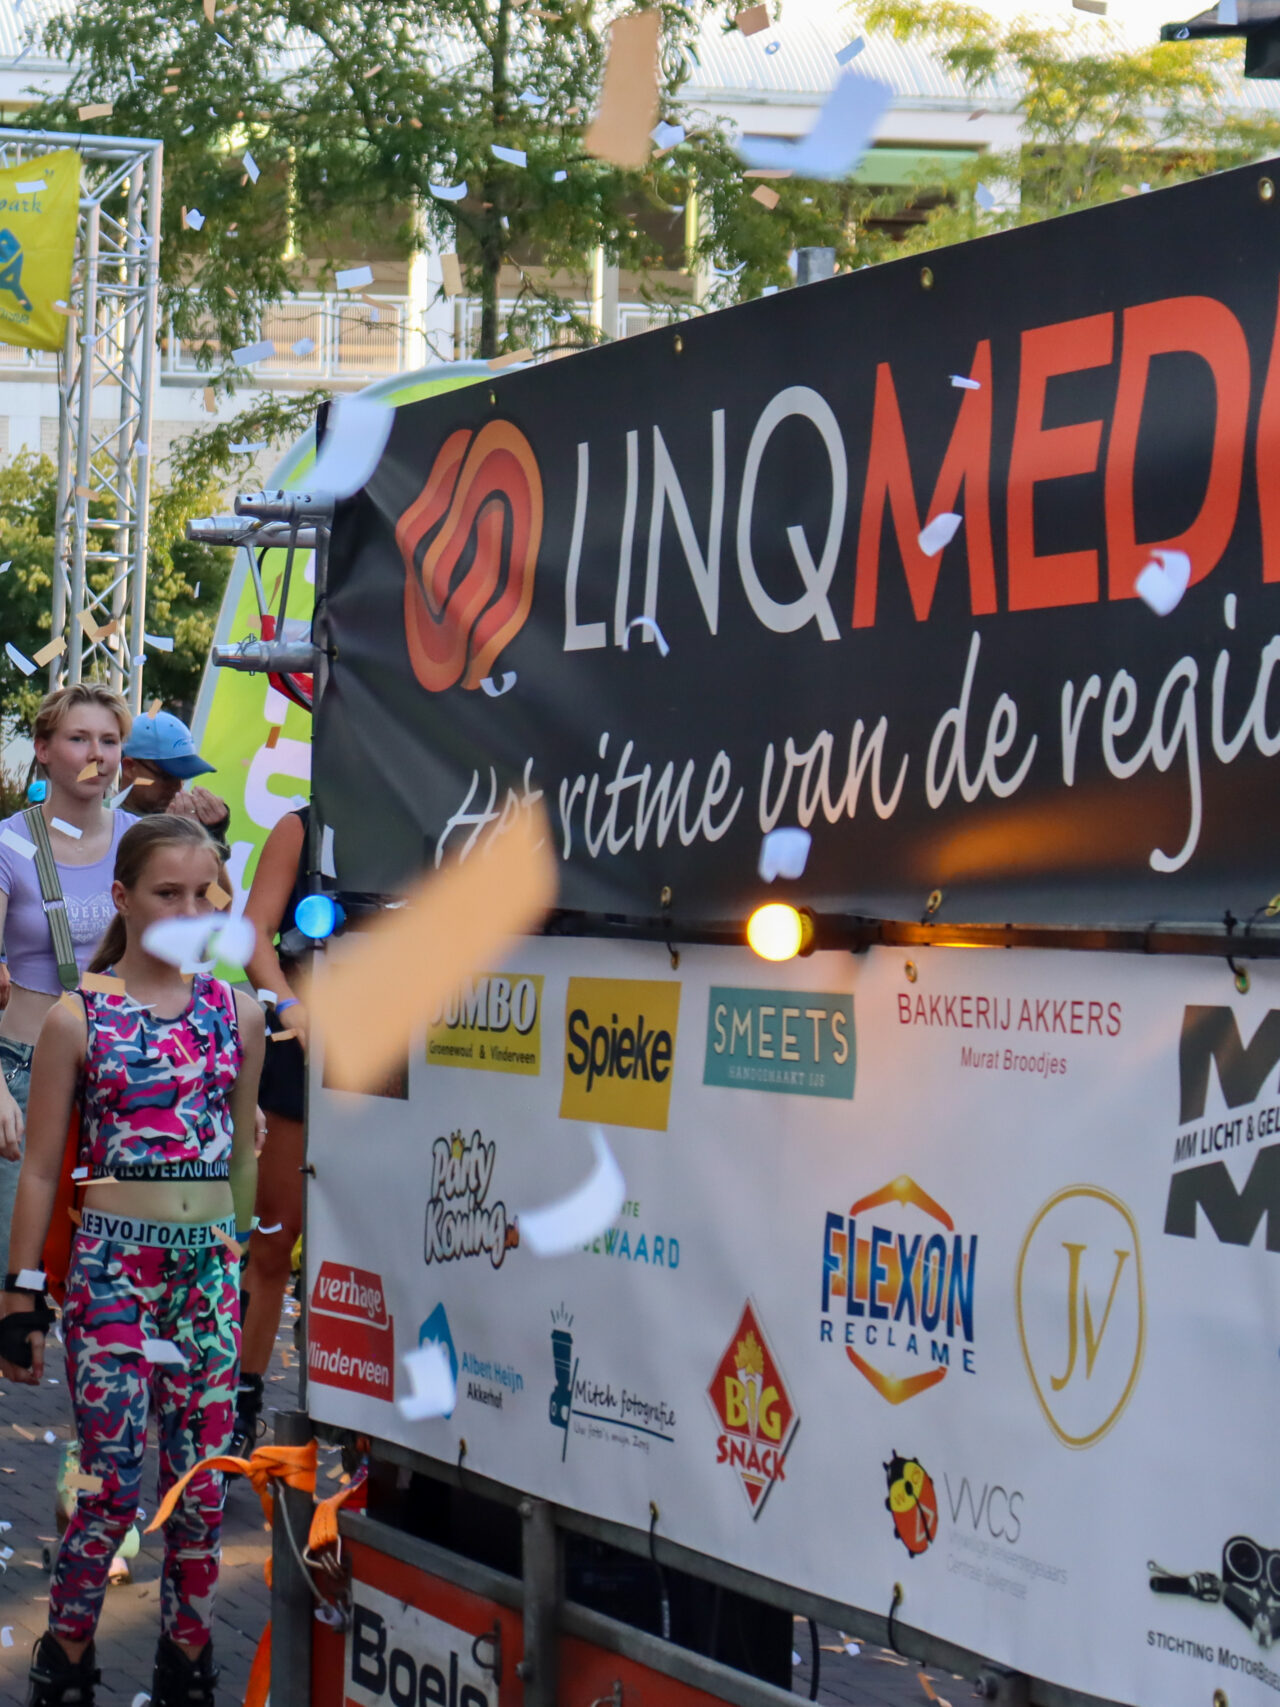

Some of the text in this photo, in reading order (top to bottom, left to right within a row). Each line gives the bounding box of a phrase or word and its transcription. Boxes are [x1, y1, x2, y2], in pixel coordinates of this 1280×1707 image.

[559, 732, 743, 861] ritme
[759, 715, 909, 834] van
[926, 631, 1038, 809] de
[70, 905, 111, 920] UEEN
[713, 1003, 849, 1066] SMEETS
[897, 993, 1122, 1037] BAKKERIJ AKKERS
[479, 1044, 486, 1060] &
[567, 1009, 672, 1093] Spieke
[961, 1046, 1067, 1079] Murat Broodjes
[1173, 1131, 1198, 1164] MM
[1200, 1118, 1244, 1155] LICHT
[1246, 1114, 1255, 1143] &
[430, 1129, 496, 1208] Party
[320, 1271, 382, 1319] verhage
[822, 1211, 978, 1343] FLEXON
[820, 1319, 976, 1374] RECLAME
[462, 1351, 524, 1394] Albert Heijn
[574, 1379, 676, 1431] Mitch fotografie
[725, 1376, 782, 1441] BIG
[716, 1435, 786, 1481] SNACK
[944, 1472, 1024, 1544] WCS
[1146, 1629, 1214, 1664] STICHTING
